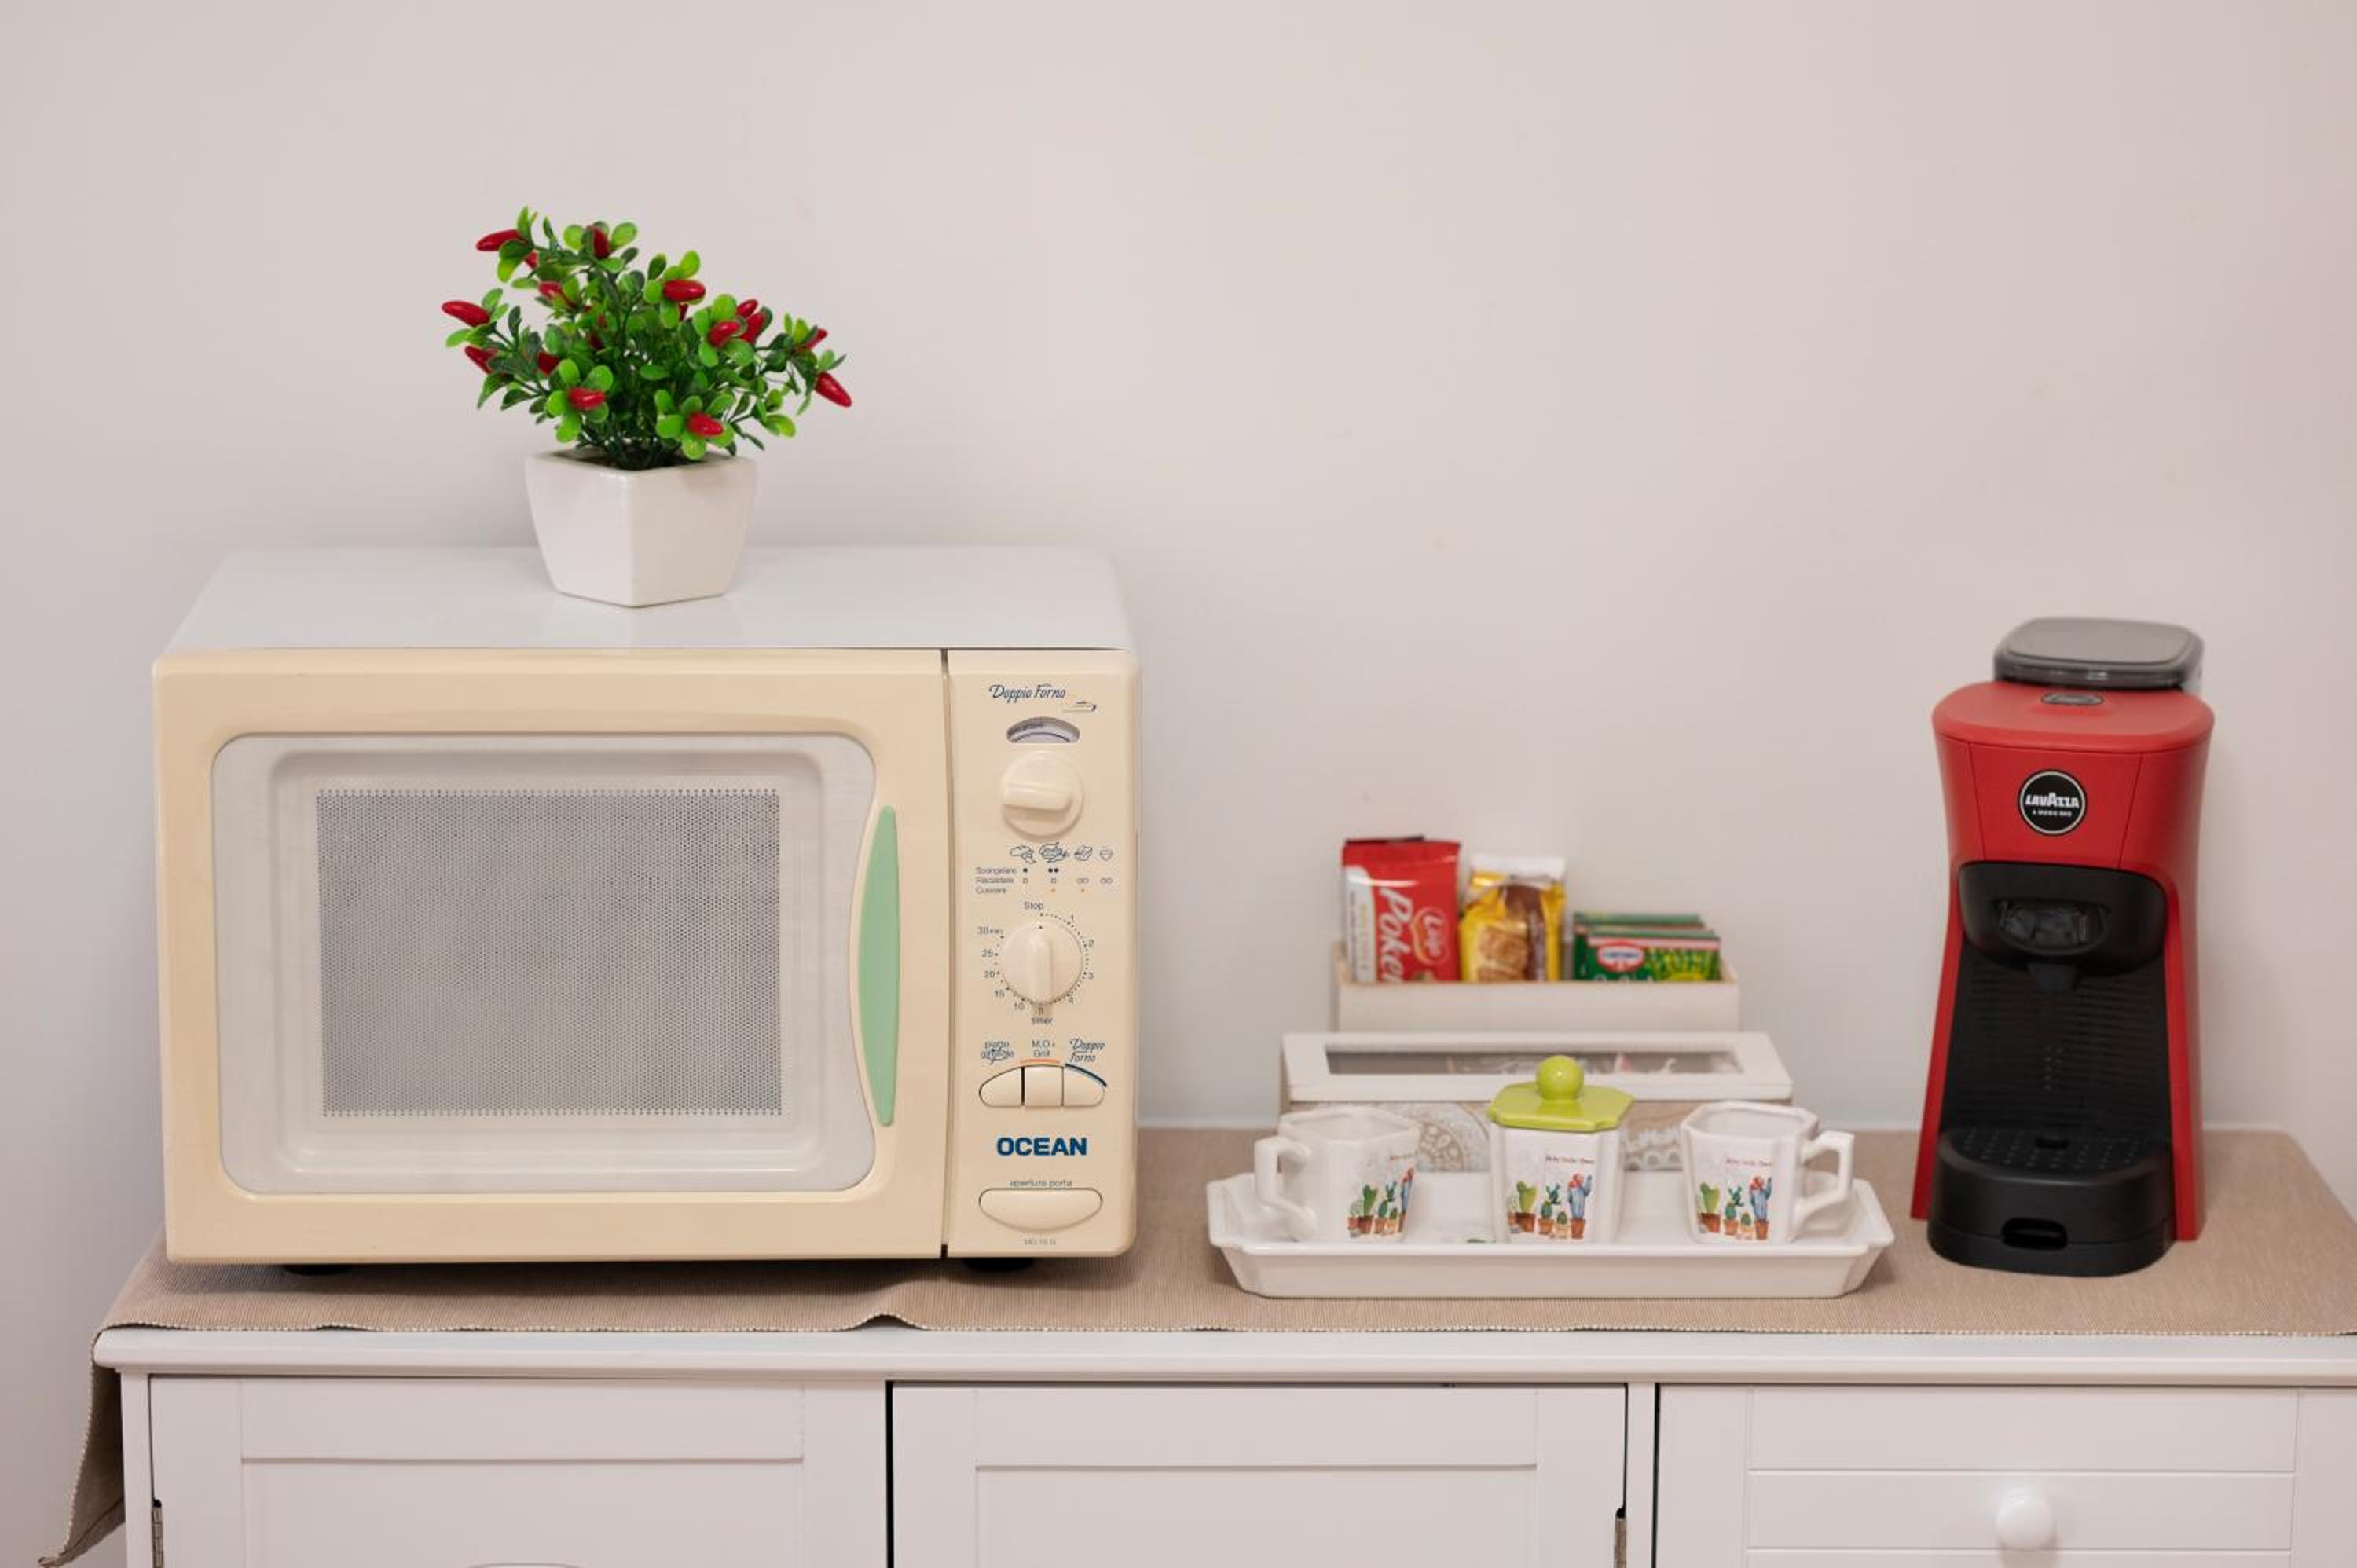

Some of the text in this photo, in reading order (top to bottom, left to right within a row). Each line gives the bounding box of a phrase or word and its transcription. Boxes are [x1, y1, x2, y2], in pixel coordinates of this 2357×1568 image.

[988, 683, 1066, 704] Doppio Forno
[2025, 791, 2080, 808] LAVAZZA
[1024, 900, 1044, 911] Stop
[1088, 940, 1094, 948] 2
[981, 949, 994, 958] 25
[983, 970, 996, 979] 20
[1088, 972, 1094, 980] 3
[994, 989, 1005, 998] 15
[1068, 996, 1075, 1005] 4
[1014, 1002, 1025, 1011] 10
[1069, 1038, 1106, 1053] Doppio
[1033, 1049, 1050, 1057] Grill
[1069, 1050, 1097, 1063] Forno
[996, 1137, 1087, 1156] OCEAN
[1009, 1178, 1073, 1188] apertura porta
